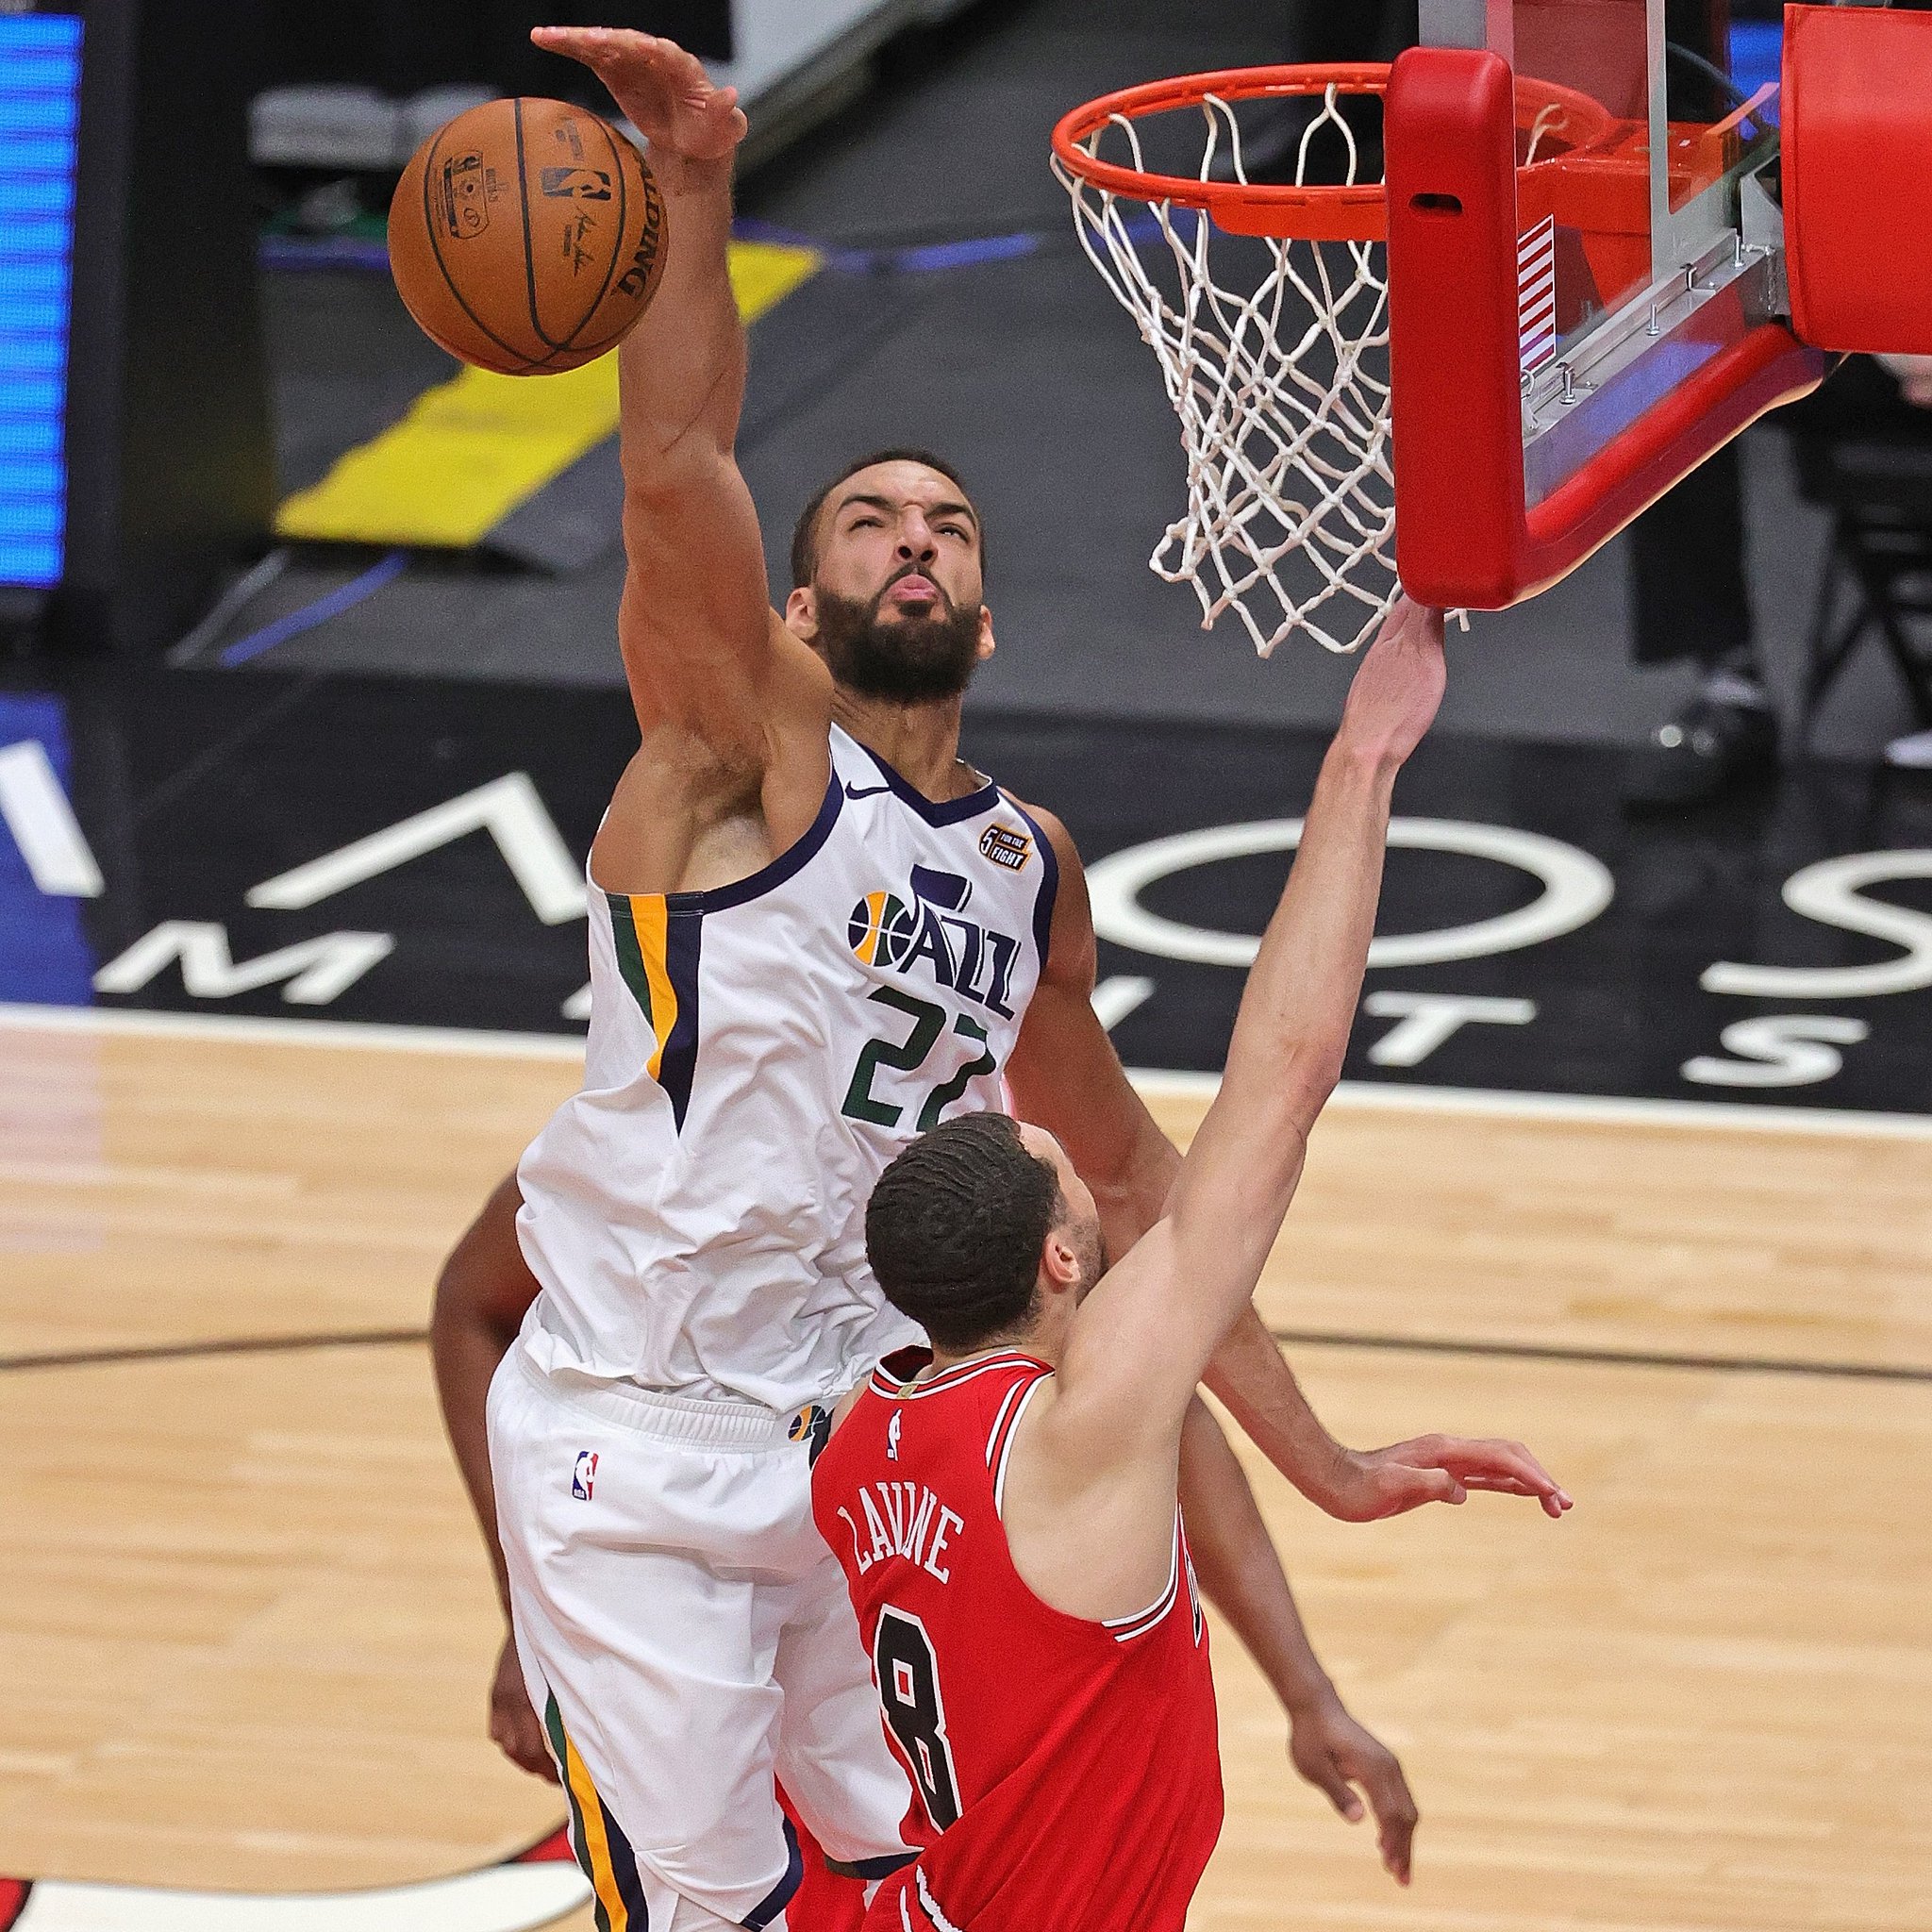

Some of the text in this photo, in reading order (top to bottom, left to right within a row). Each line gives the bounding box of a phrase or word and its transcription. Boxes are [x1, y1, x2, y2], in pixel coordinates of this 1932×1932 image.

[981, 828, 998, 854] 5
[991, 846, 1024, 867] FIGHT
[848, 863, 1022, 1021] JAZZ
[837, 1482, 964, 1584] LAVINE
[874, 1603, 963, 1835] 8
